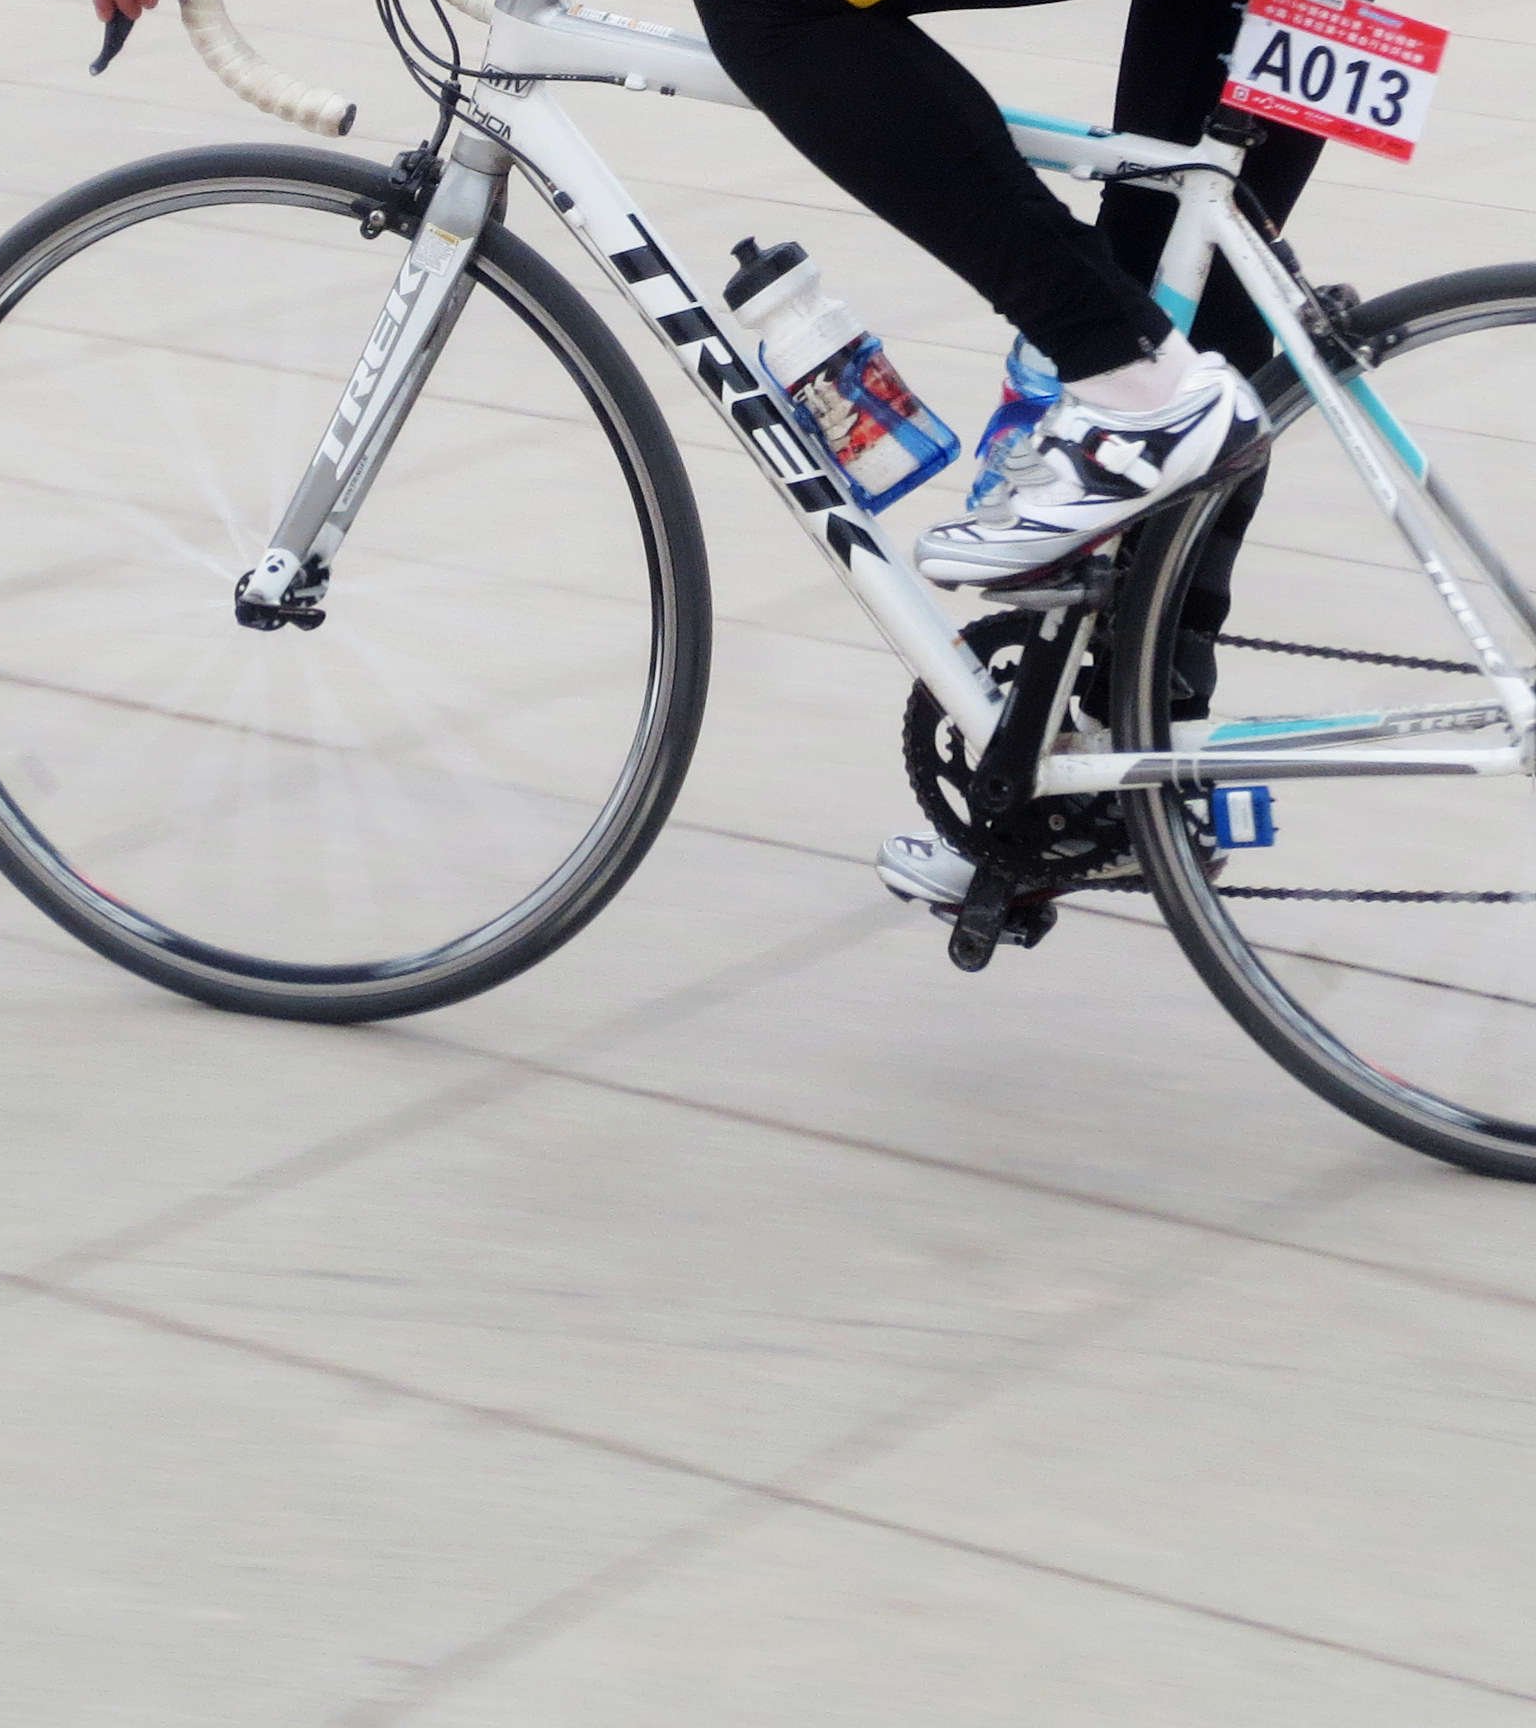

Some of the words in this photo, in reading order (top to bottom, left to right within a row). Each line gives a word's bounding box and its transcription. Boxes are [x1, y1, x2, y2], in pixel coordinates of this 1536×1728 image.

[1246, 28, 1410, 128] A013
[312, 252, 426, 466] TREK
[609, 212, 891, 572] TREK
[1423, 551, 1508, 667] TREK
